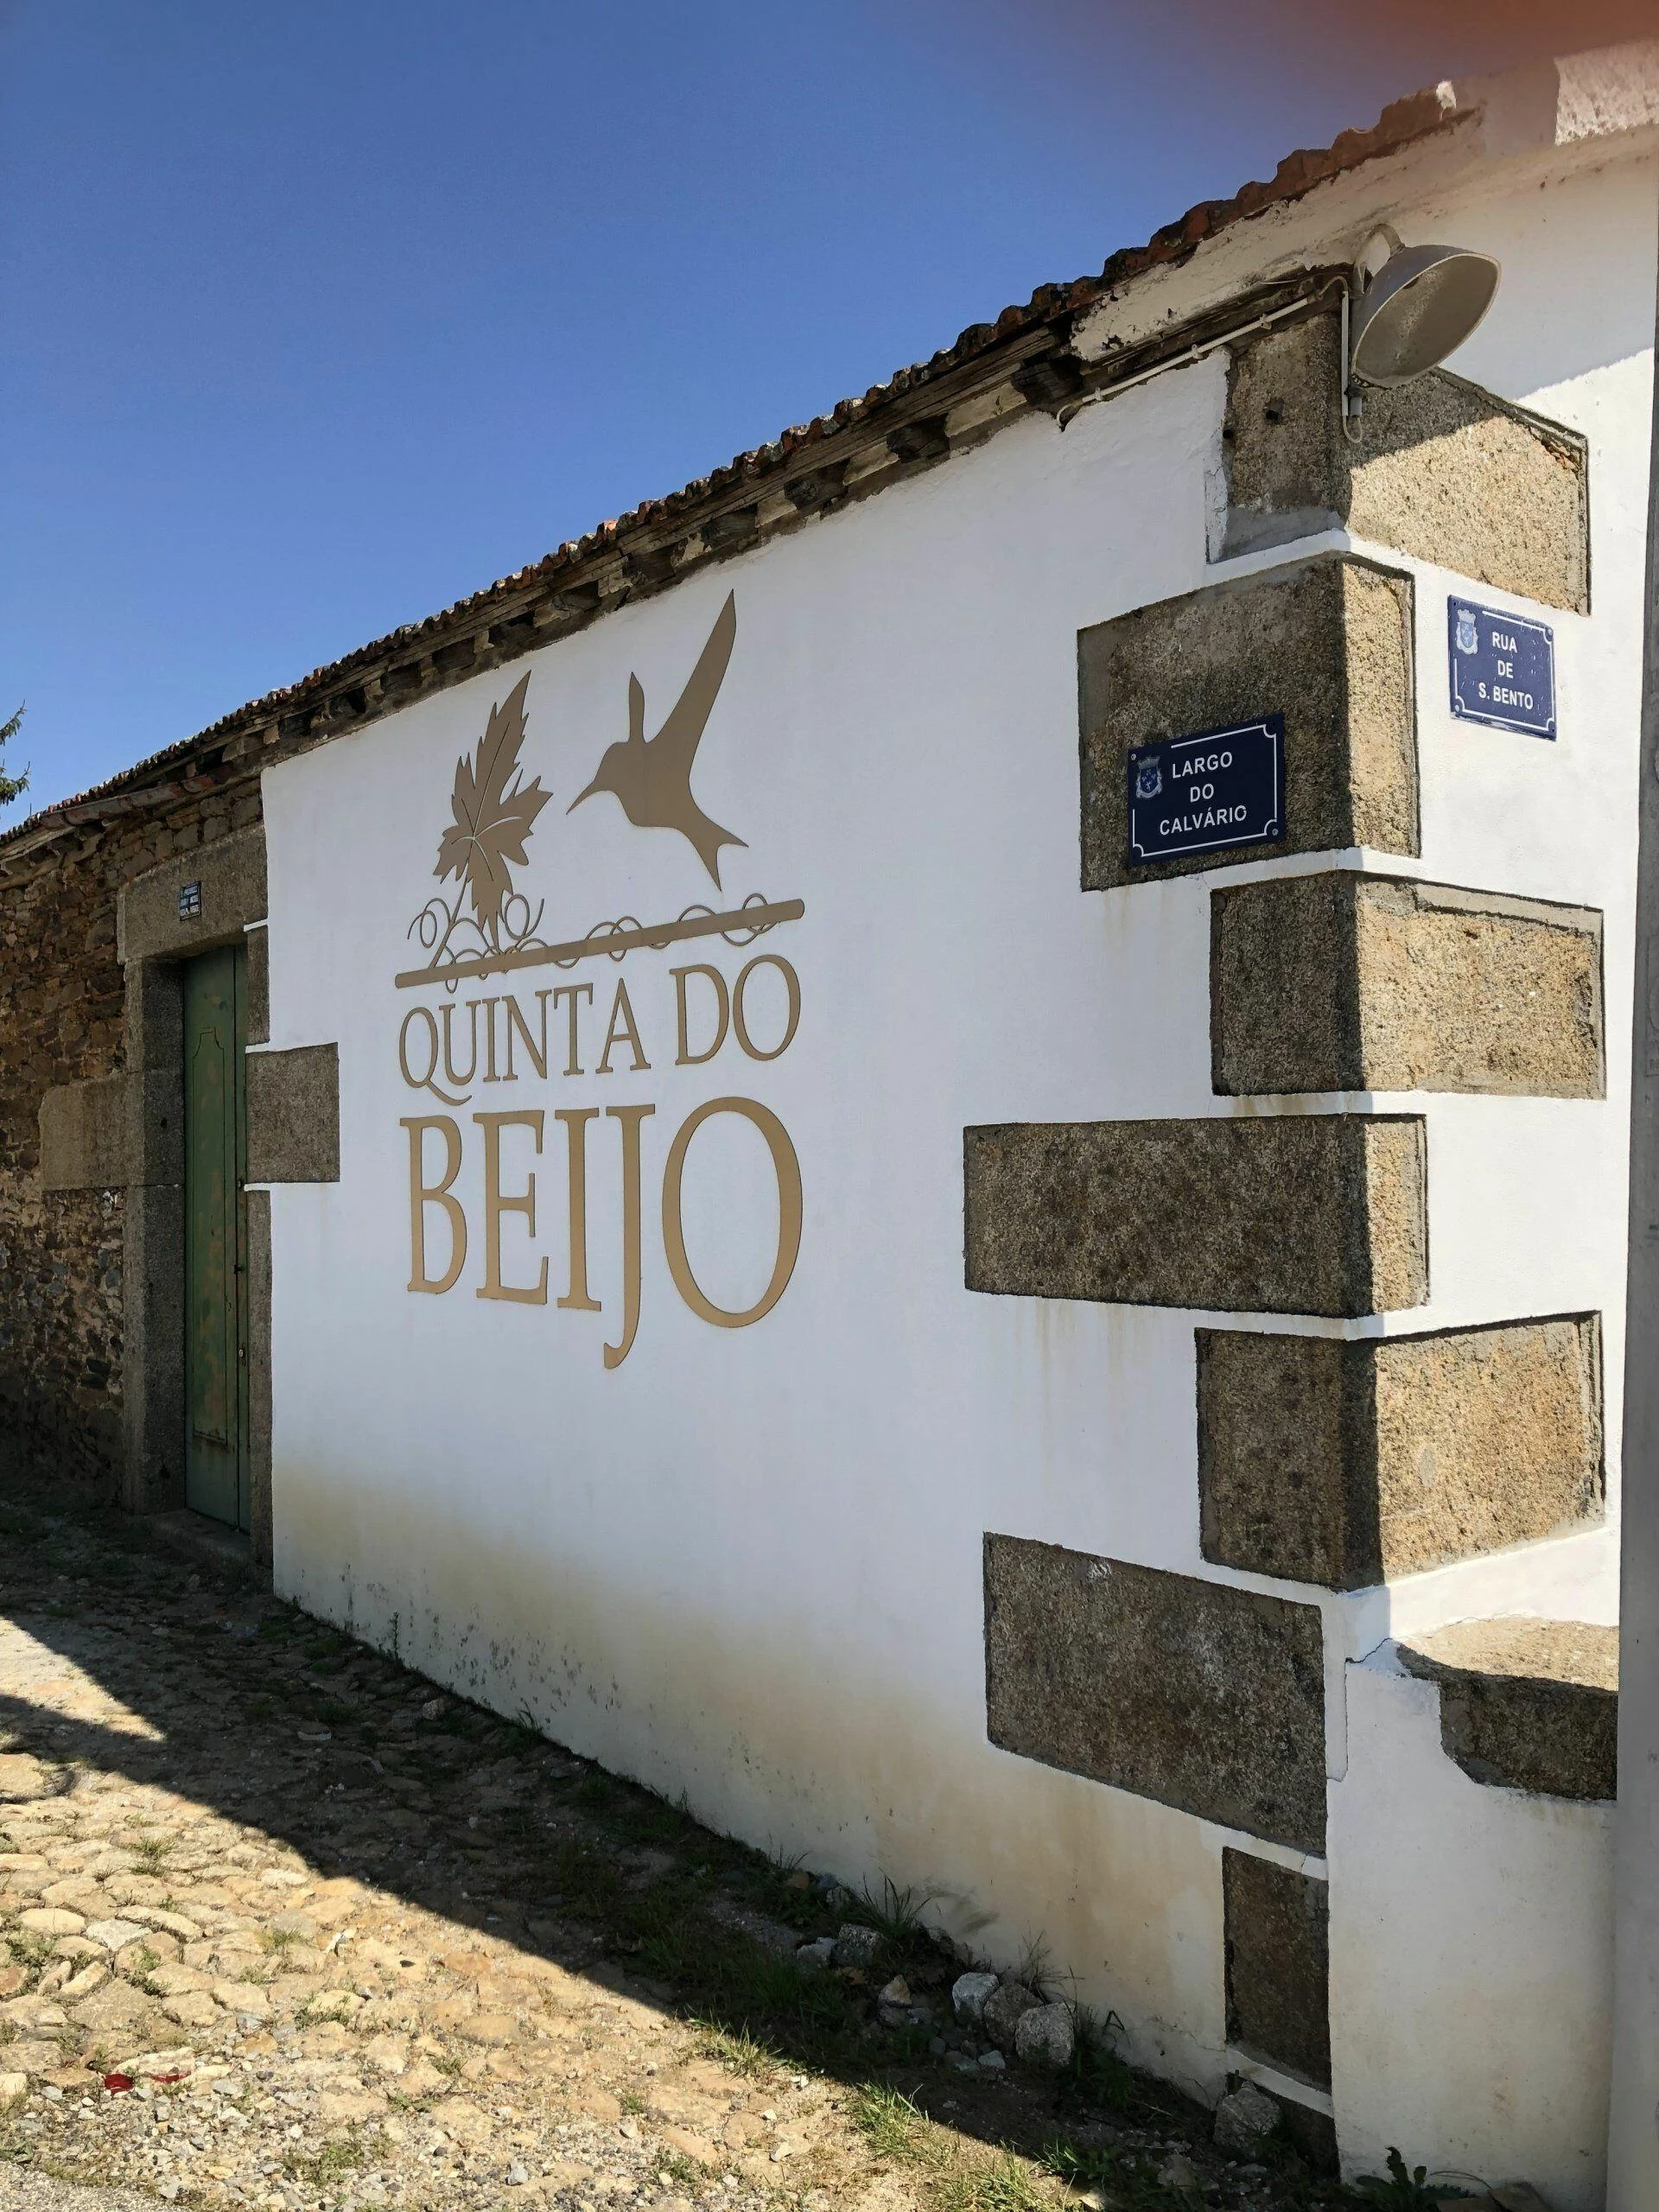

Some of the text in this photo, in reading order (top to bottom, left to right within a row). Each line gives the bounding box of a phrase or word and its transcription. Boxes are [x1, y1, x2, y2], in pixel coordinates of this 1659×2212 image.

[1491, 631, 1518, 653] RUA
[1497, 659, 1514, 679] DE
[1478, 682, 1534, 710] S. BENTO
[1172, 751, 1233, 779] LARGO
[1190, 783, 1215, 803] DO
[1159, 804, 1248, 836] CALVÁRIO
[399, 954, 801, 1106] QUINTA DO
[399, 1096, 804, 1370] BEIJO
